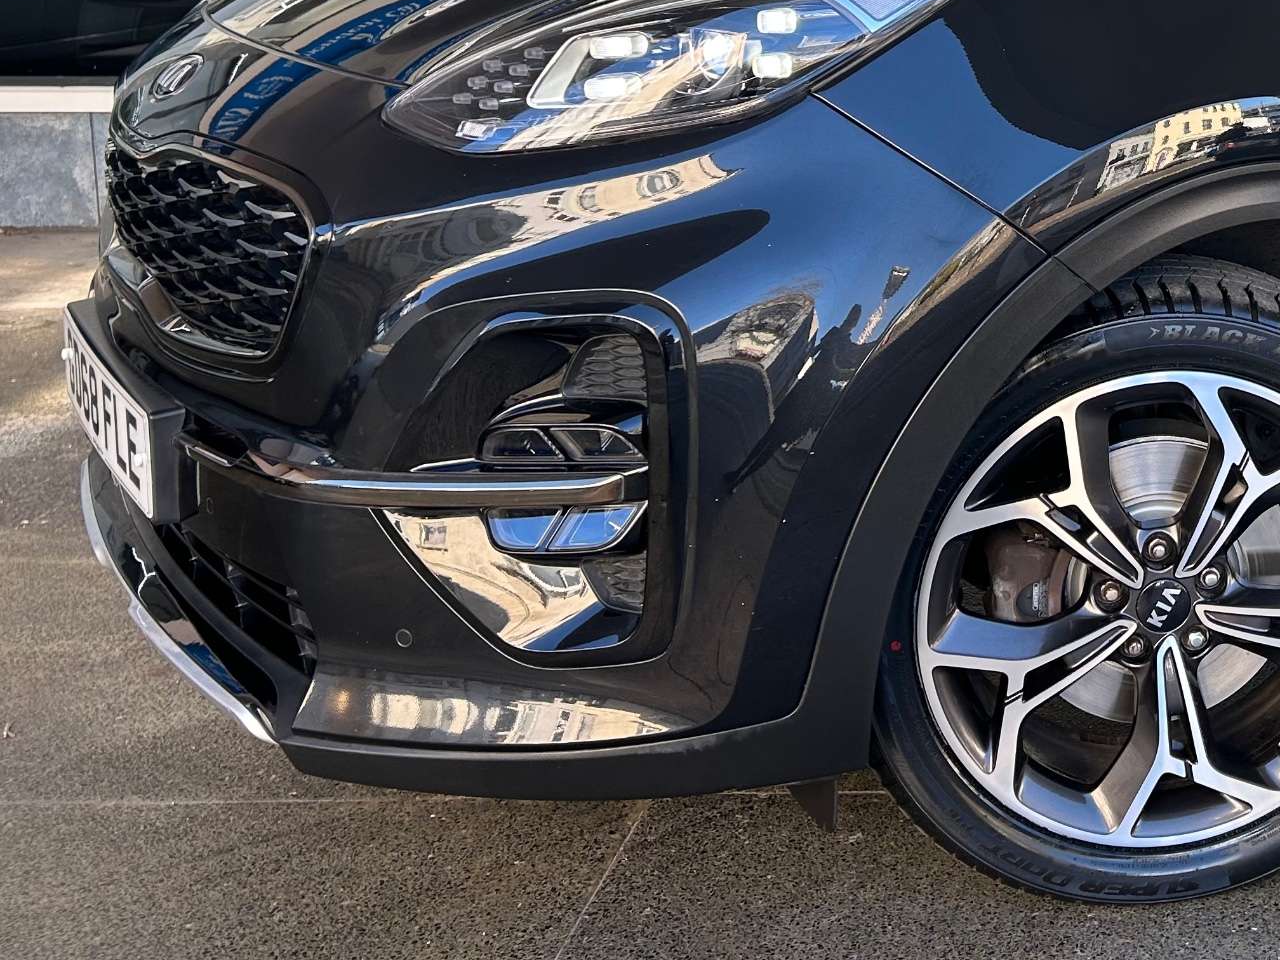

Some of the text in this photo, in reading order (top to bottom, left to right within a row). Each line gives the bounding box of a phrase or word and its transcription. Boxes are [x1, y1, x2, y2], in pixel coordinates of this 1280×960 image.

[1163, 324, 1268, 346] BLACK
[101, 379, 141, 491] FLE
[1146, 588, 1182, 628] KIA
